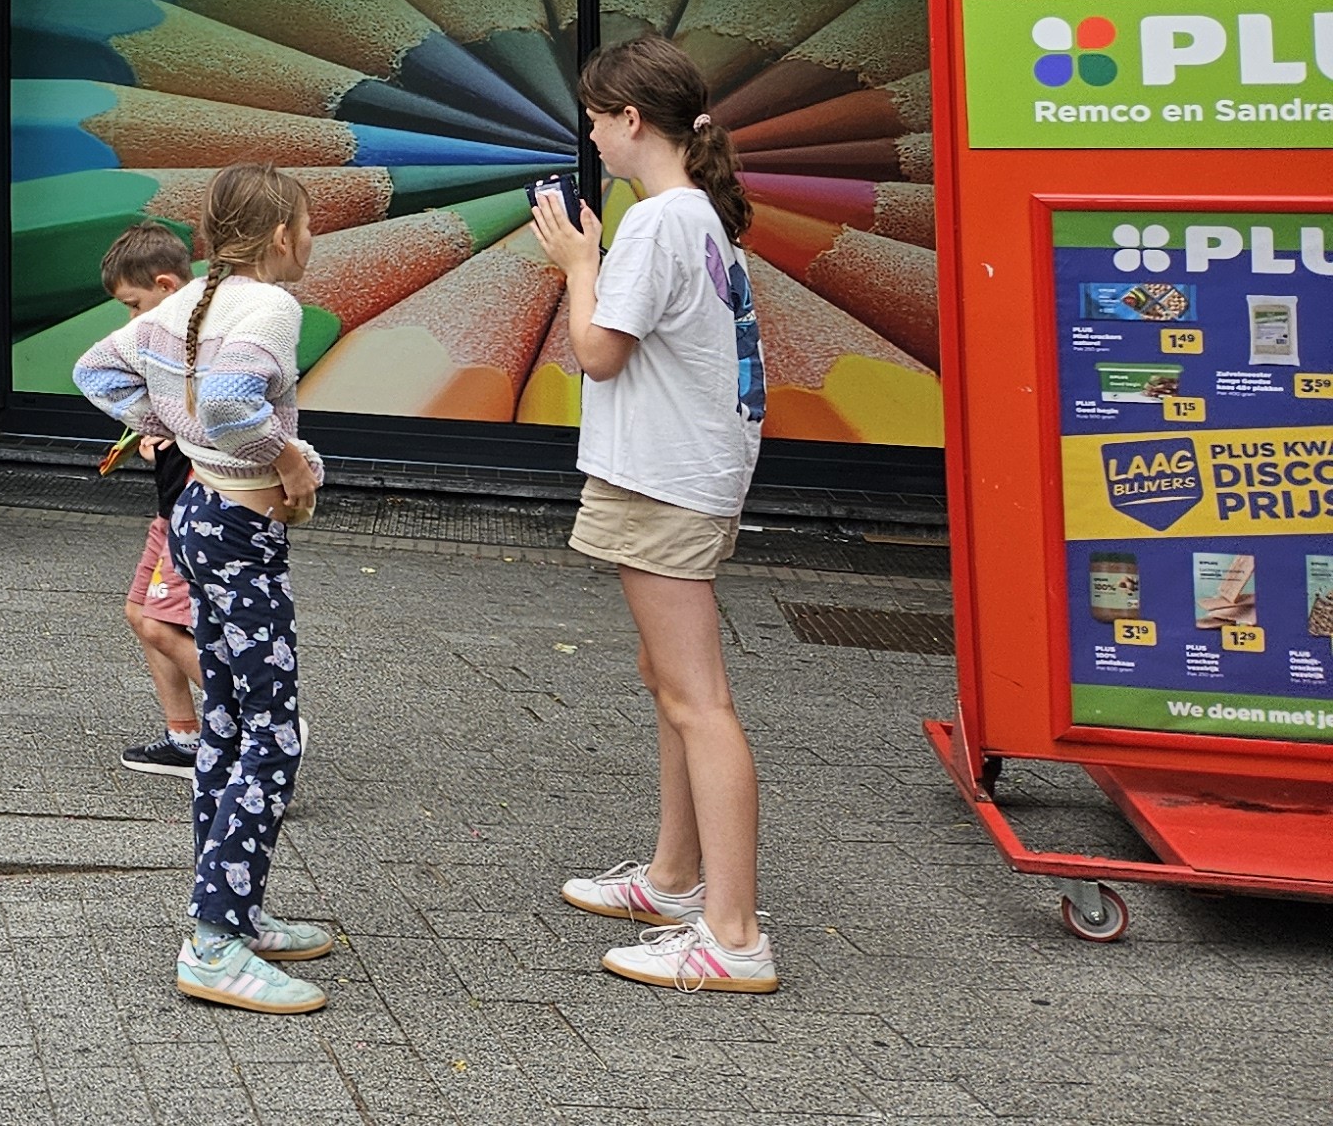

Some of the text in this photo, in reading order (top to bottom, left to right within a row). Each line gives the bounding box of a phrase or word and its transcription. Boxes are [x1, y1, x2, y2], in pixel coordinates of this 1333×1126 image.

[1140, 12, 1333, 86] PL
[1034, 97, 1333, 123] Remco en Sandra
[1210, 442, 1276, 460] PLUS
[1108, 450, 1195, 481] LAAG
[1113, 476, 1196, 496] BLIJVERS
[1166, 700, 1204, 718] We
[1207, 703, 1266, 722] doen
[1268, 709, 1315, 725] met
